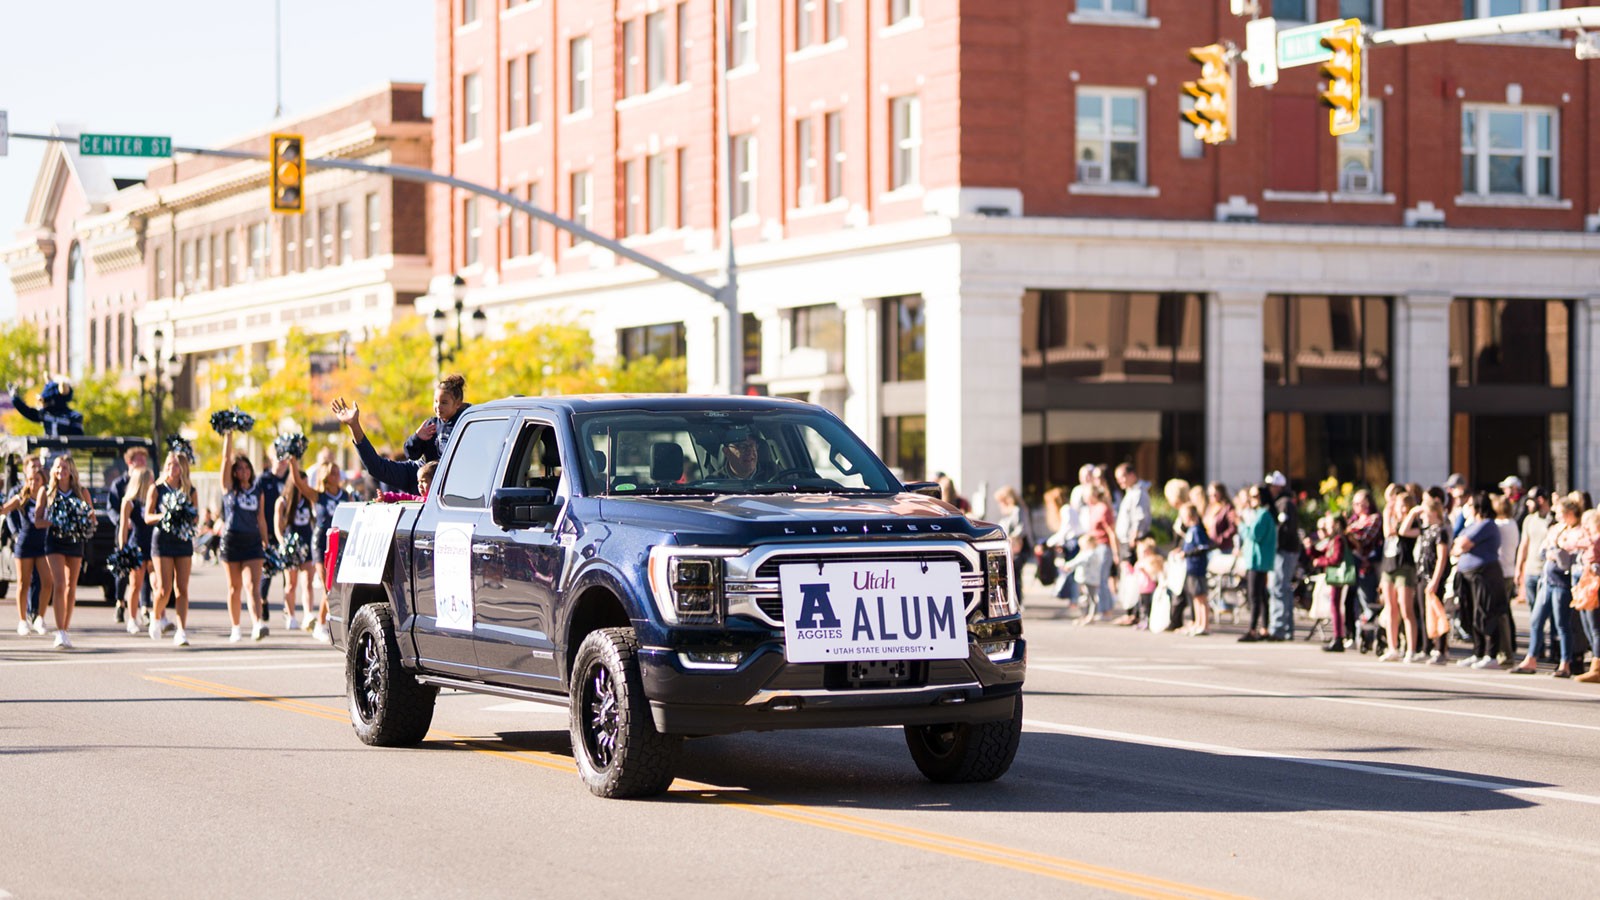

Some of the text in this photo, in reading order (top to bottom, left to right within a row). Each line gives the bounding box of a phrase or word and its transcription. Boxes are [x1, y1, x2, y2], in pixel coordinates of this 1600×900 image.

[81, 136, 143, 154] CENTER
[784, 524, 942, 534] LIMITED
[354, 531, 391, 568] ALUM
[853, 569, 895, 591] Utah
[795, 583, 841, 629] A
[851, 595, 956, 641] ALUM
[797, 629, 843, 640] AGGIES
[833, 645, 927, 655] UTAH STATE UNIVERSITY
